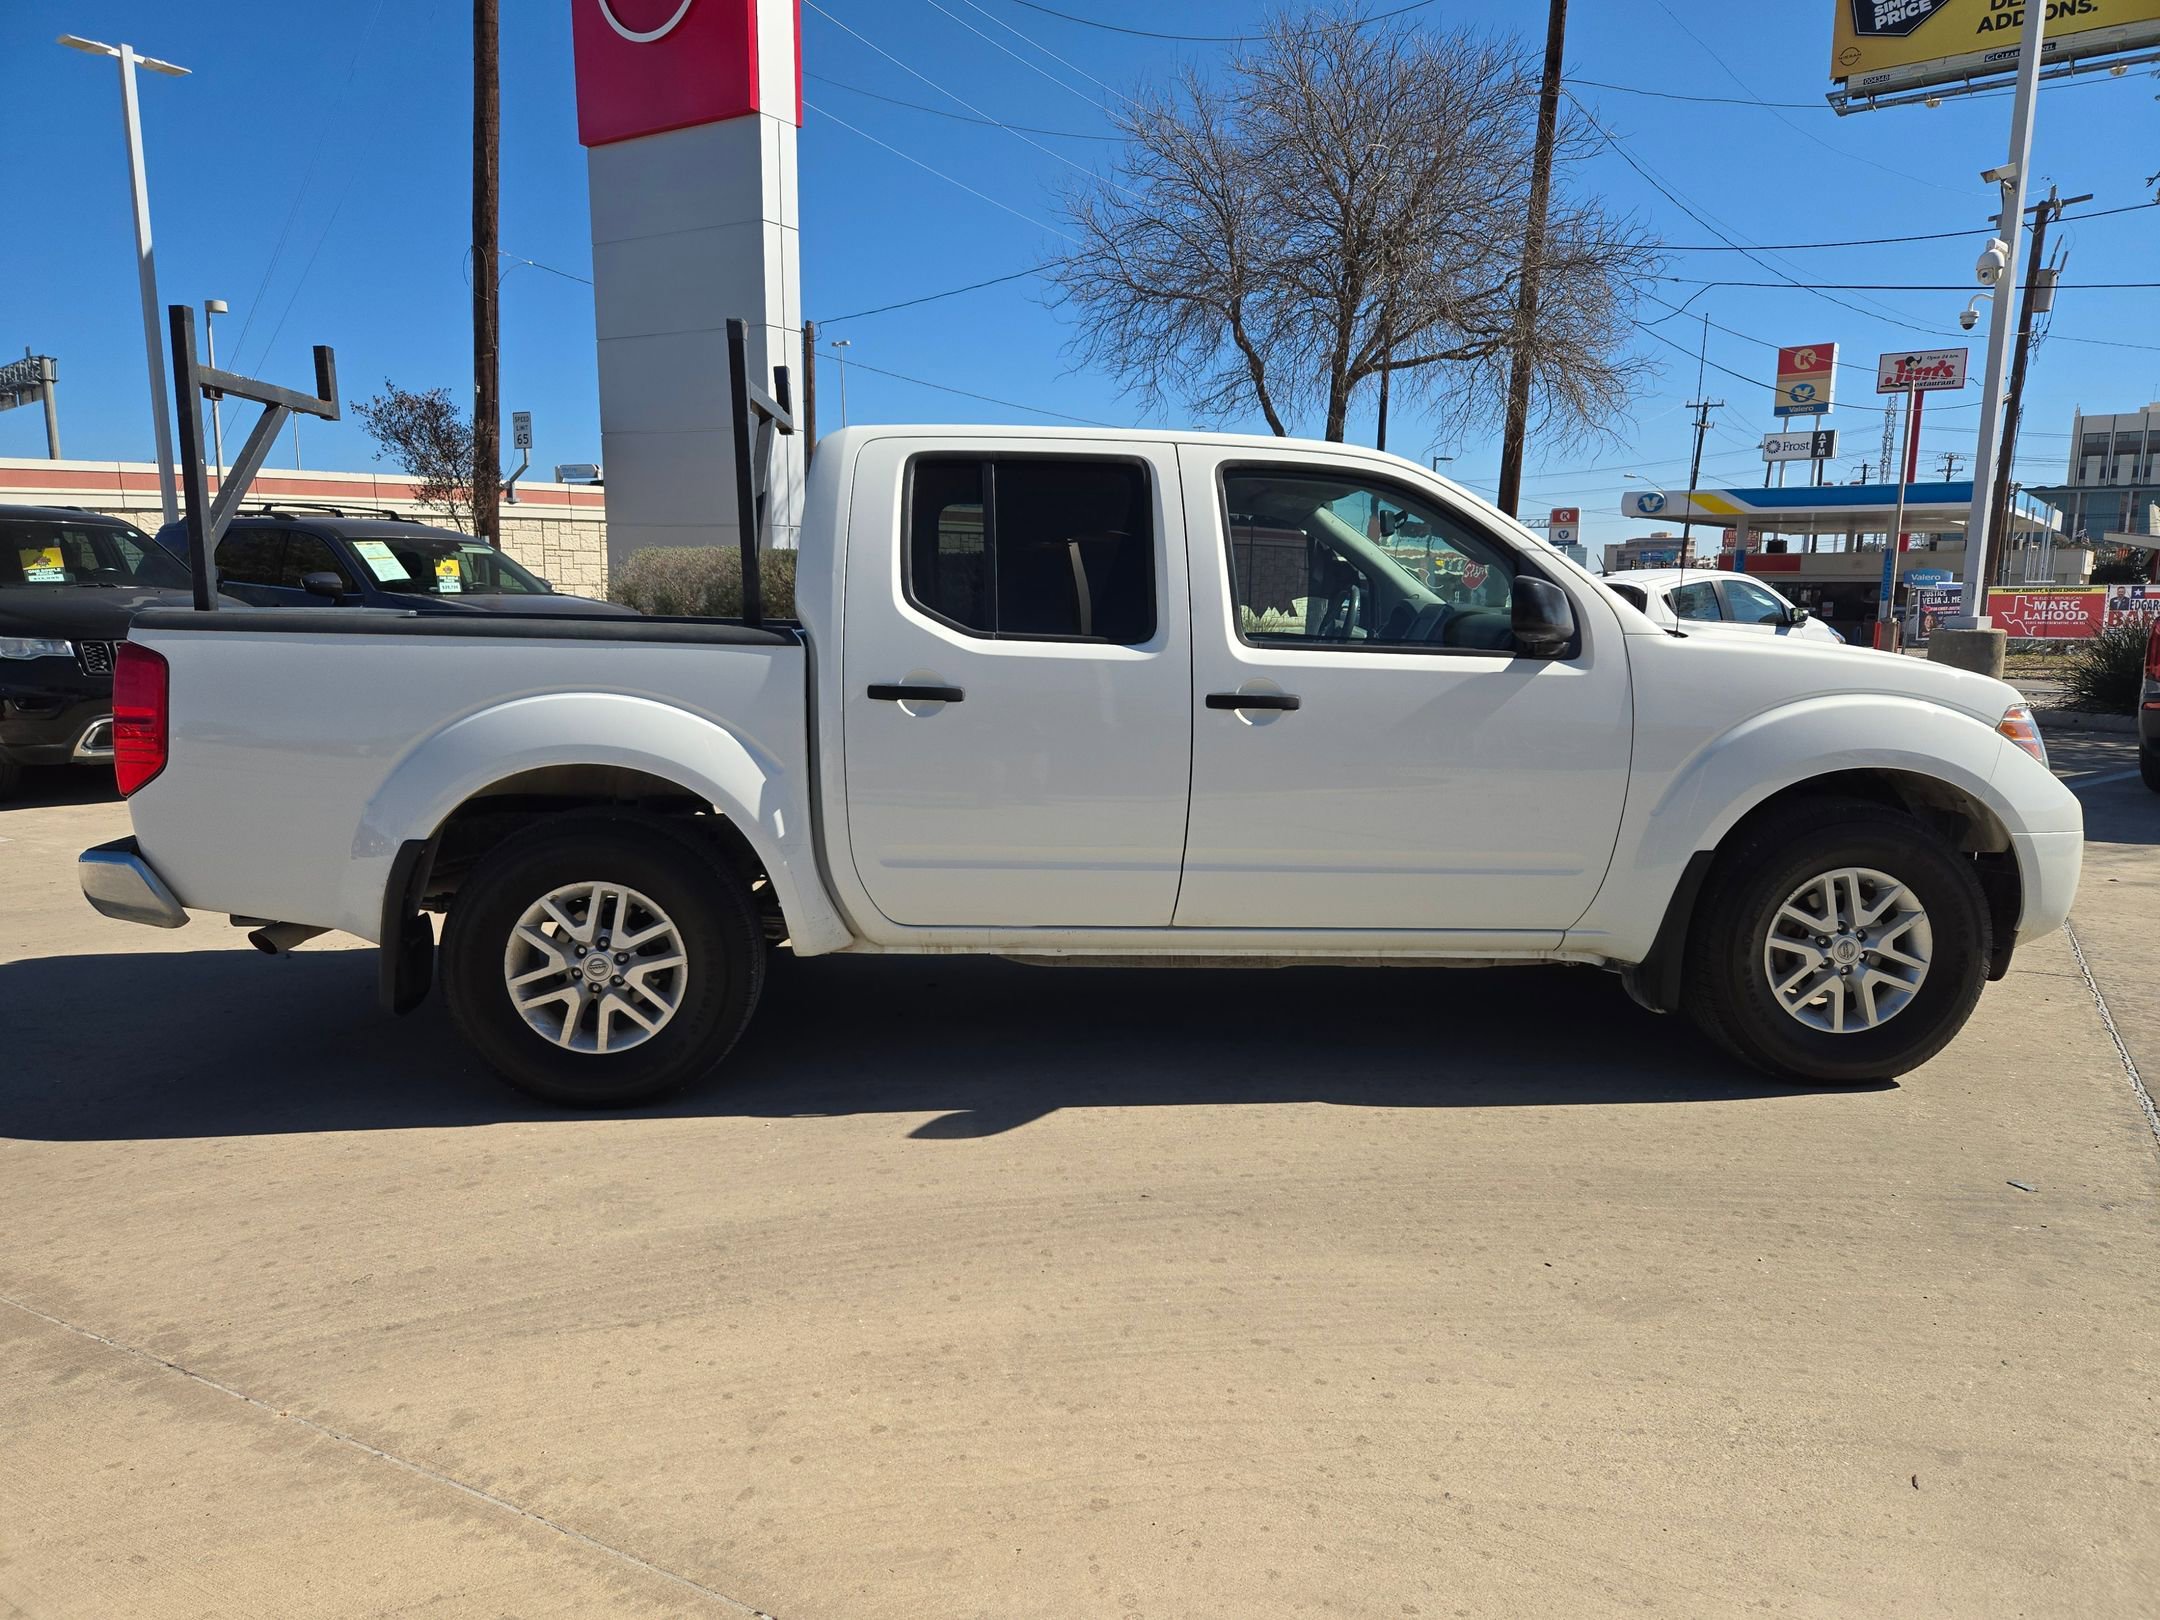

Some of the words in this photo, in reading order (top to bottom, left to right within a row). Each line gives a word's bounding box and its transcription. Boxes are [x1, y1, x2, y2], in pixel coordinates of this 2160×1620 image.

[1874, 0, 1932, 30] PRICE
[1976, 0, 2098, 34] ADDONS.
[1912, 379, 1956, 388] estaurant
[517, 433, 529, 445] 65
[1817, 432, 1827, 456] ATM
[1783, 441, 1810, 451] Frost
[1922, 597, 1942, 605] VELIA
[2033, 601, 2080, 610] MARC
